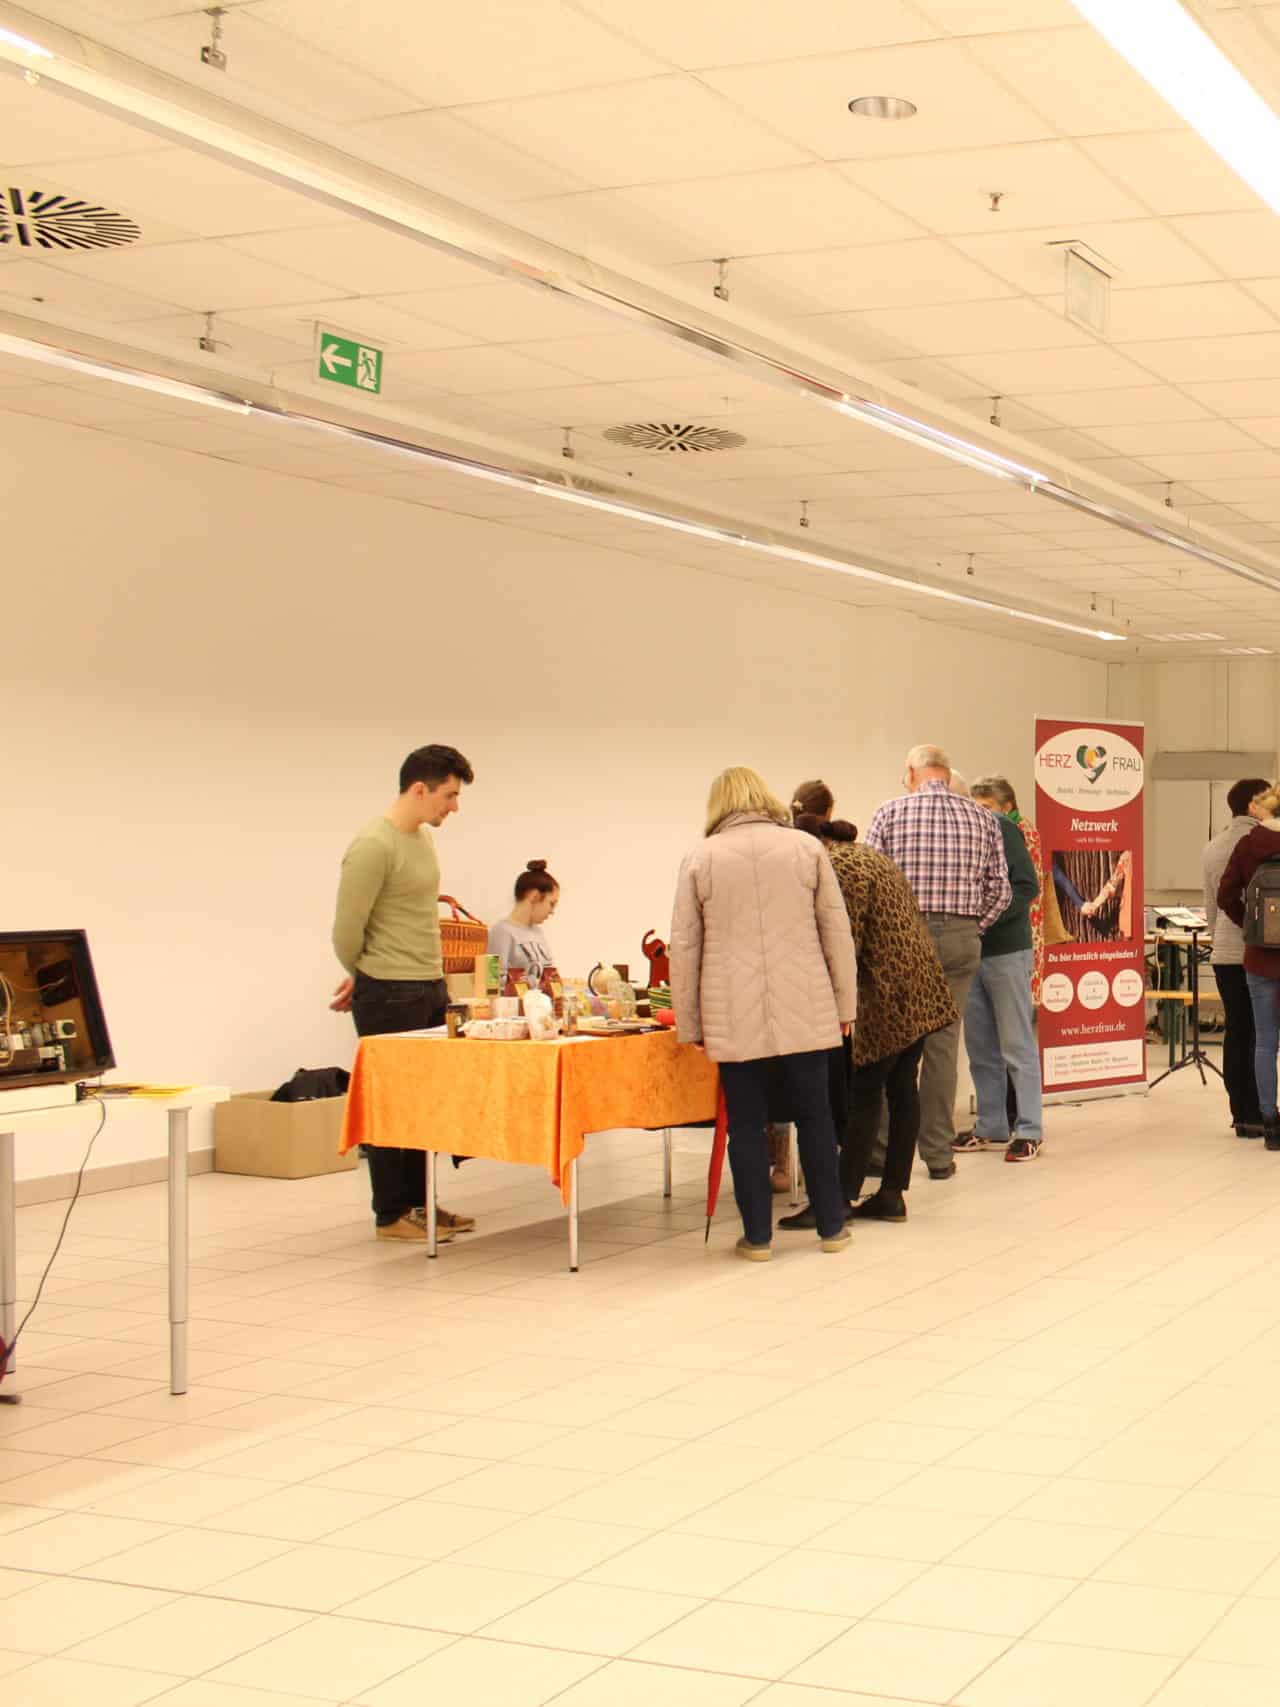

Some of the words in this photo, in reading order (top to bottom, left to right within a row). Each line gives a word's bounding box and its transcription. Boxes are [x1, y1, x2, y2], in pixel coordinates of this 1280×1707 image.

[1040, 753, 1072, 768] HERZ
[1113, 756, 1141, 772] FRAU
[1071, 818, 1118, 832] Netzwerk
[1061, 1020, 1127, 1036] www.herzfrau.de
